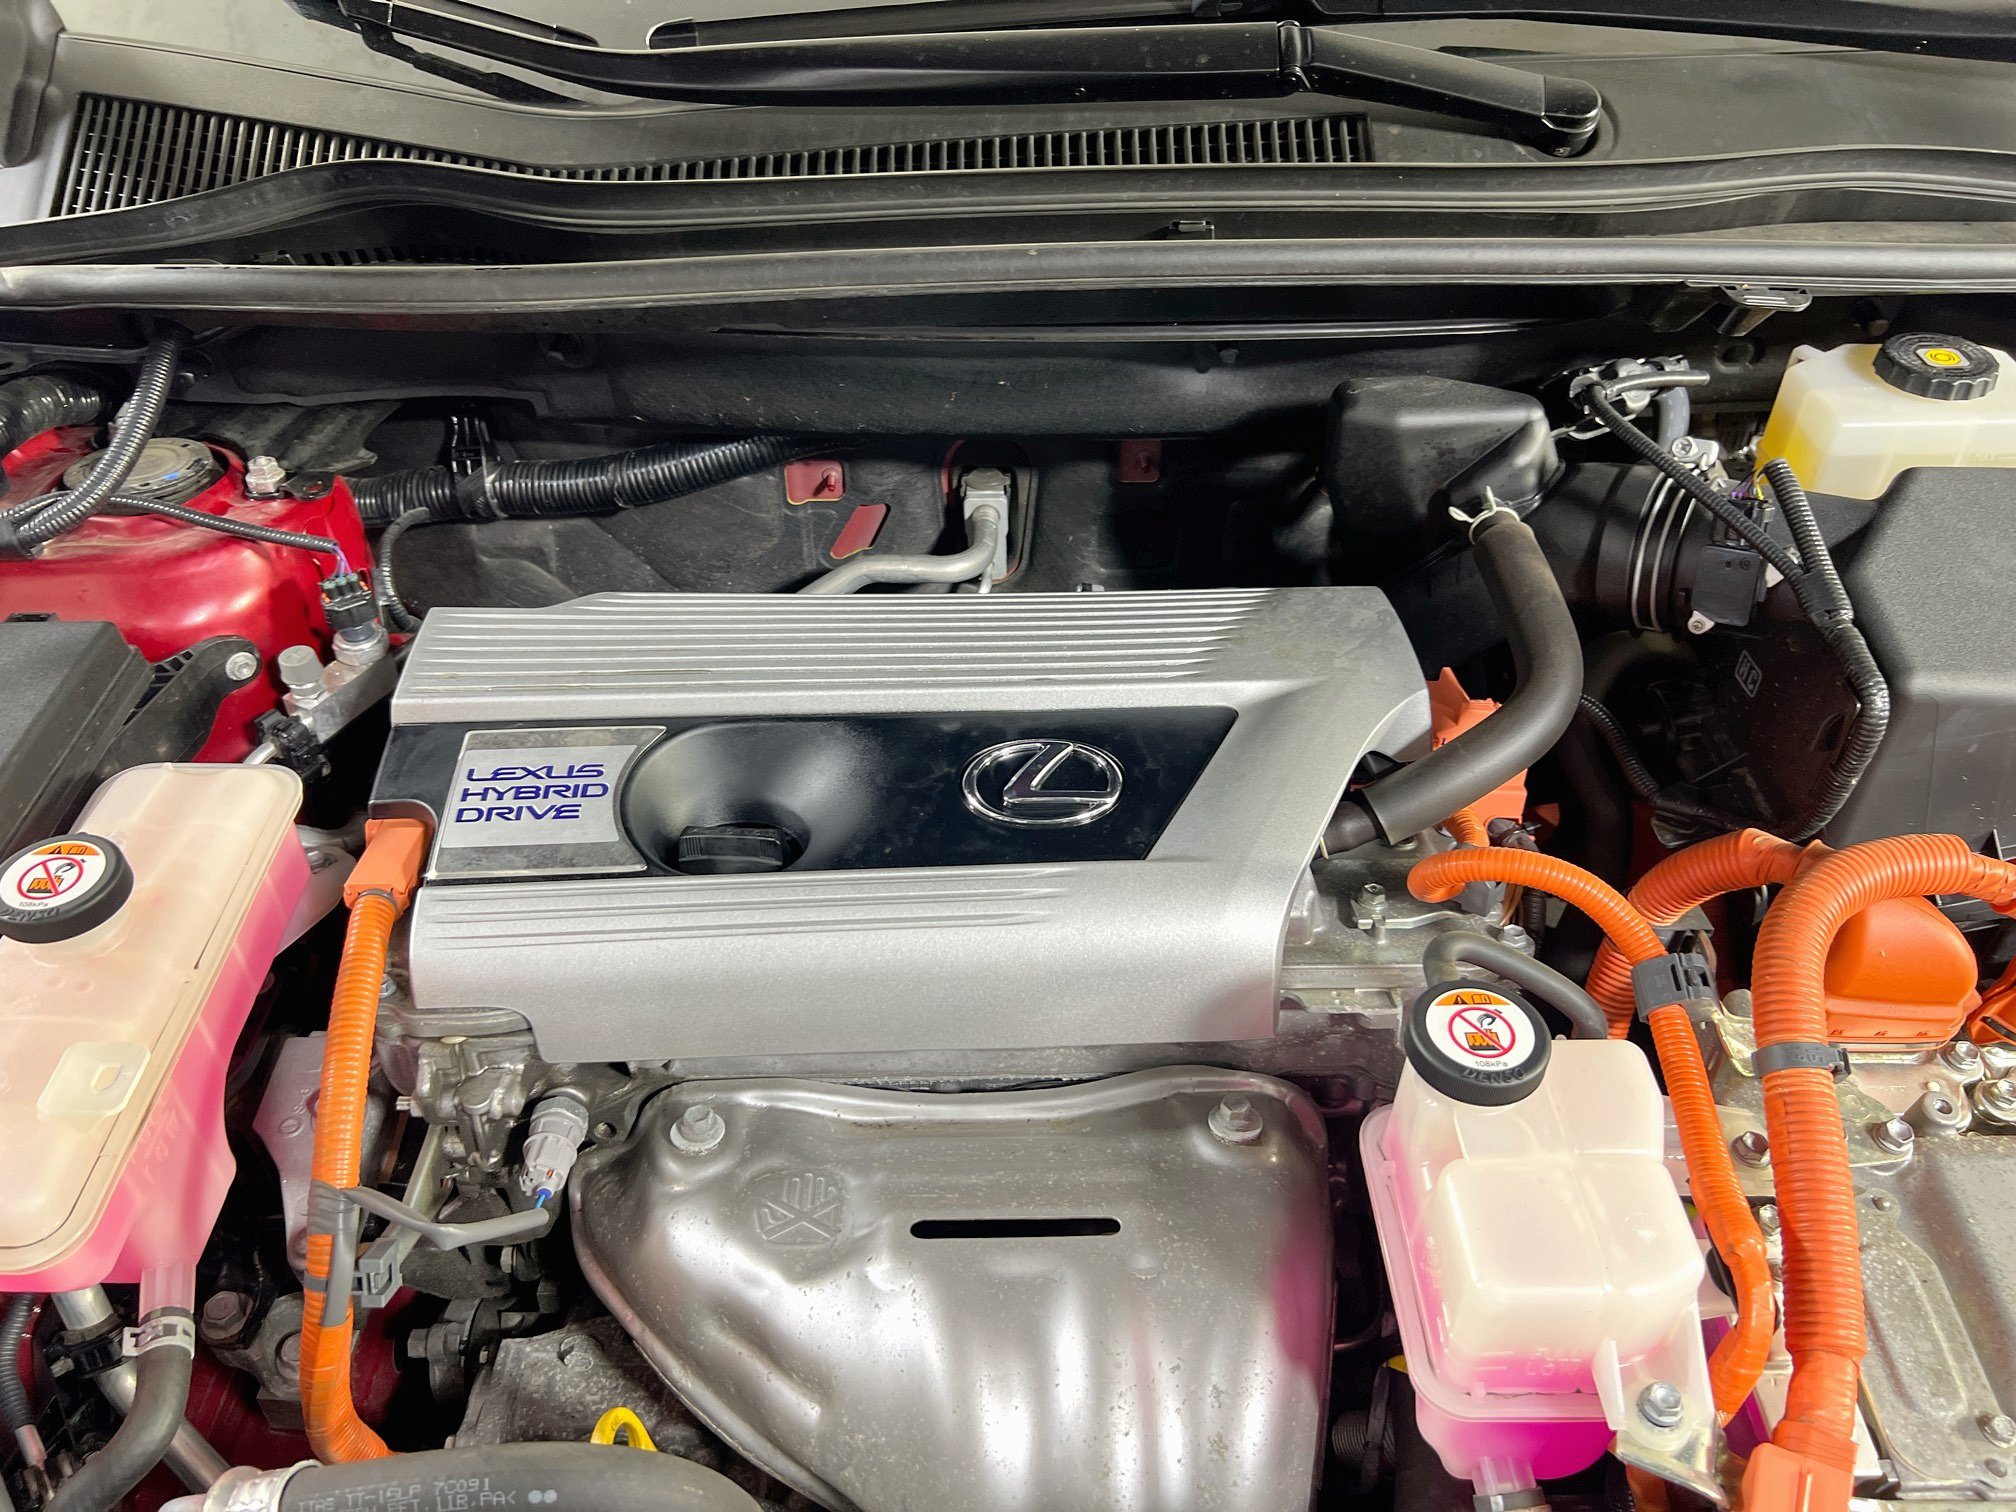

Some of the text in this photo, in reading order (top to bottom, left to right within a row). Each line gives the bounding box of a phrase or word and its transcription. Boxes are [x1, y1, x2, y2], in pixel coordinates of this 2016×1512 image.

[466, 764, 604, 782] LEXUS
[460, 783, 609, 802] HYBRID
[455, 804, 582, 823] DRIVE
[1474, 1060, 1509, 1068] 108kPa
[1460, 1067, 1525, 1084] DENSO
